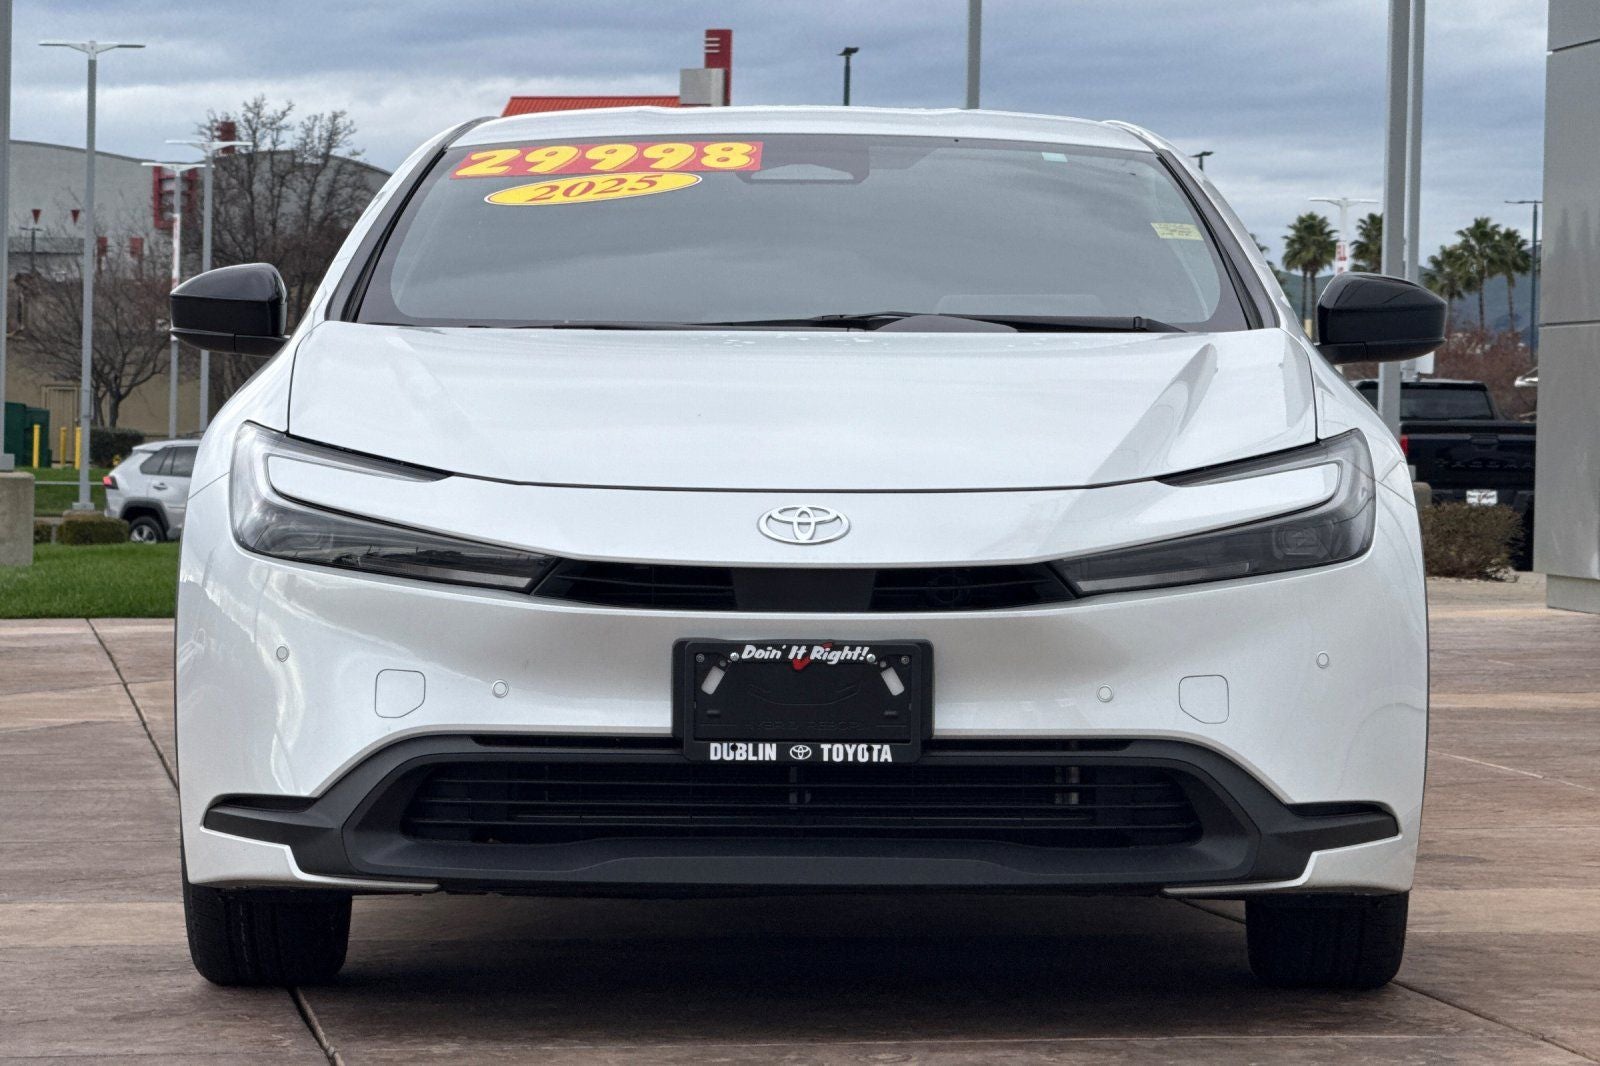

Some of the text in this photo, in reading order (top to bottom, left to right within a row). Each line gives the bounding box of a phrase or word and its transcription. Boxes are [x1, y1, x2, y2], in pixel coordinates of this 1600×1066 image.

[454, 142, 756, 177] 29998
[525, 174, 663, 203] 2025
[741, 644, 870, 665] Doin' It Right!
[709, 742, 893, 763] DUBLIN TOYOTA
